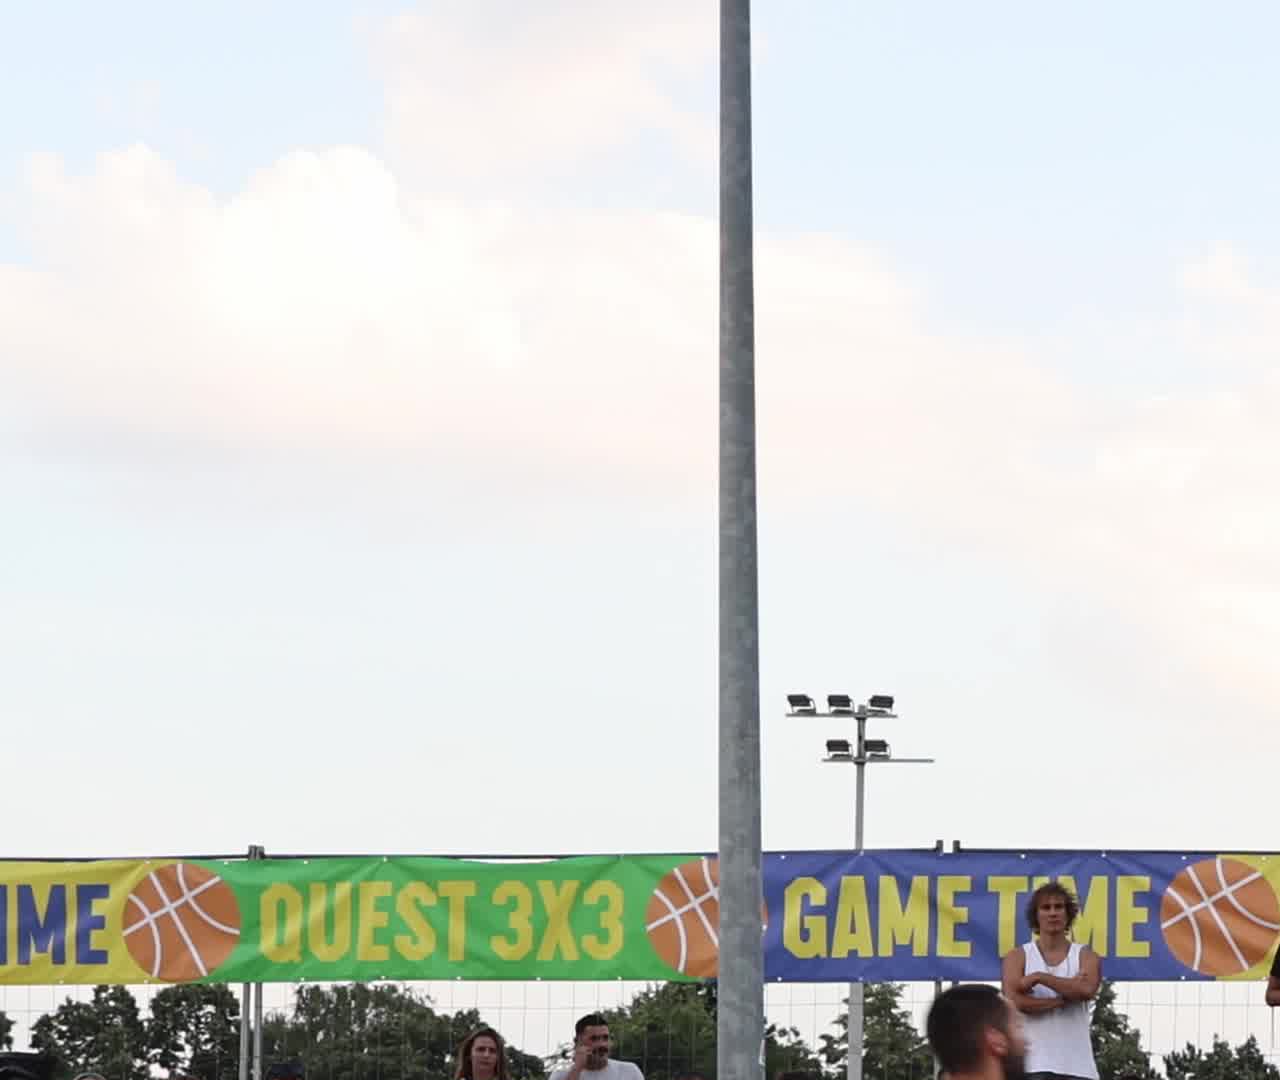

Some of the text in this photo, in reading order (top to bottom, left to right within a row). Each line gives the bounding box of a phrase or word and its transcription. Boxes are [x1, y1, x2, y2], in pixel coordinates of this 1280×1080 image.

[259, 879, 626, 963] QUEST 3X3
[783, 875, 1152, 959] GAME TME
